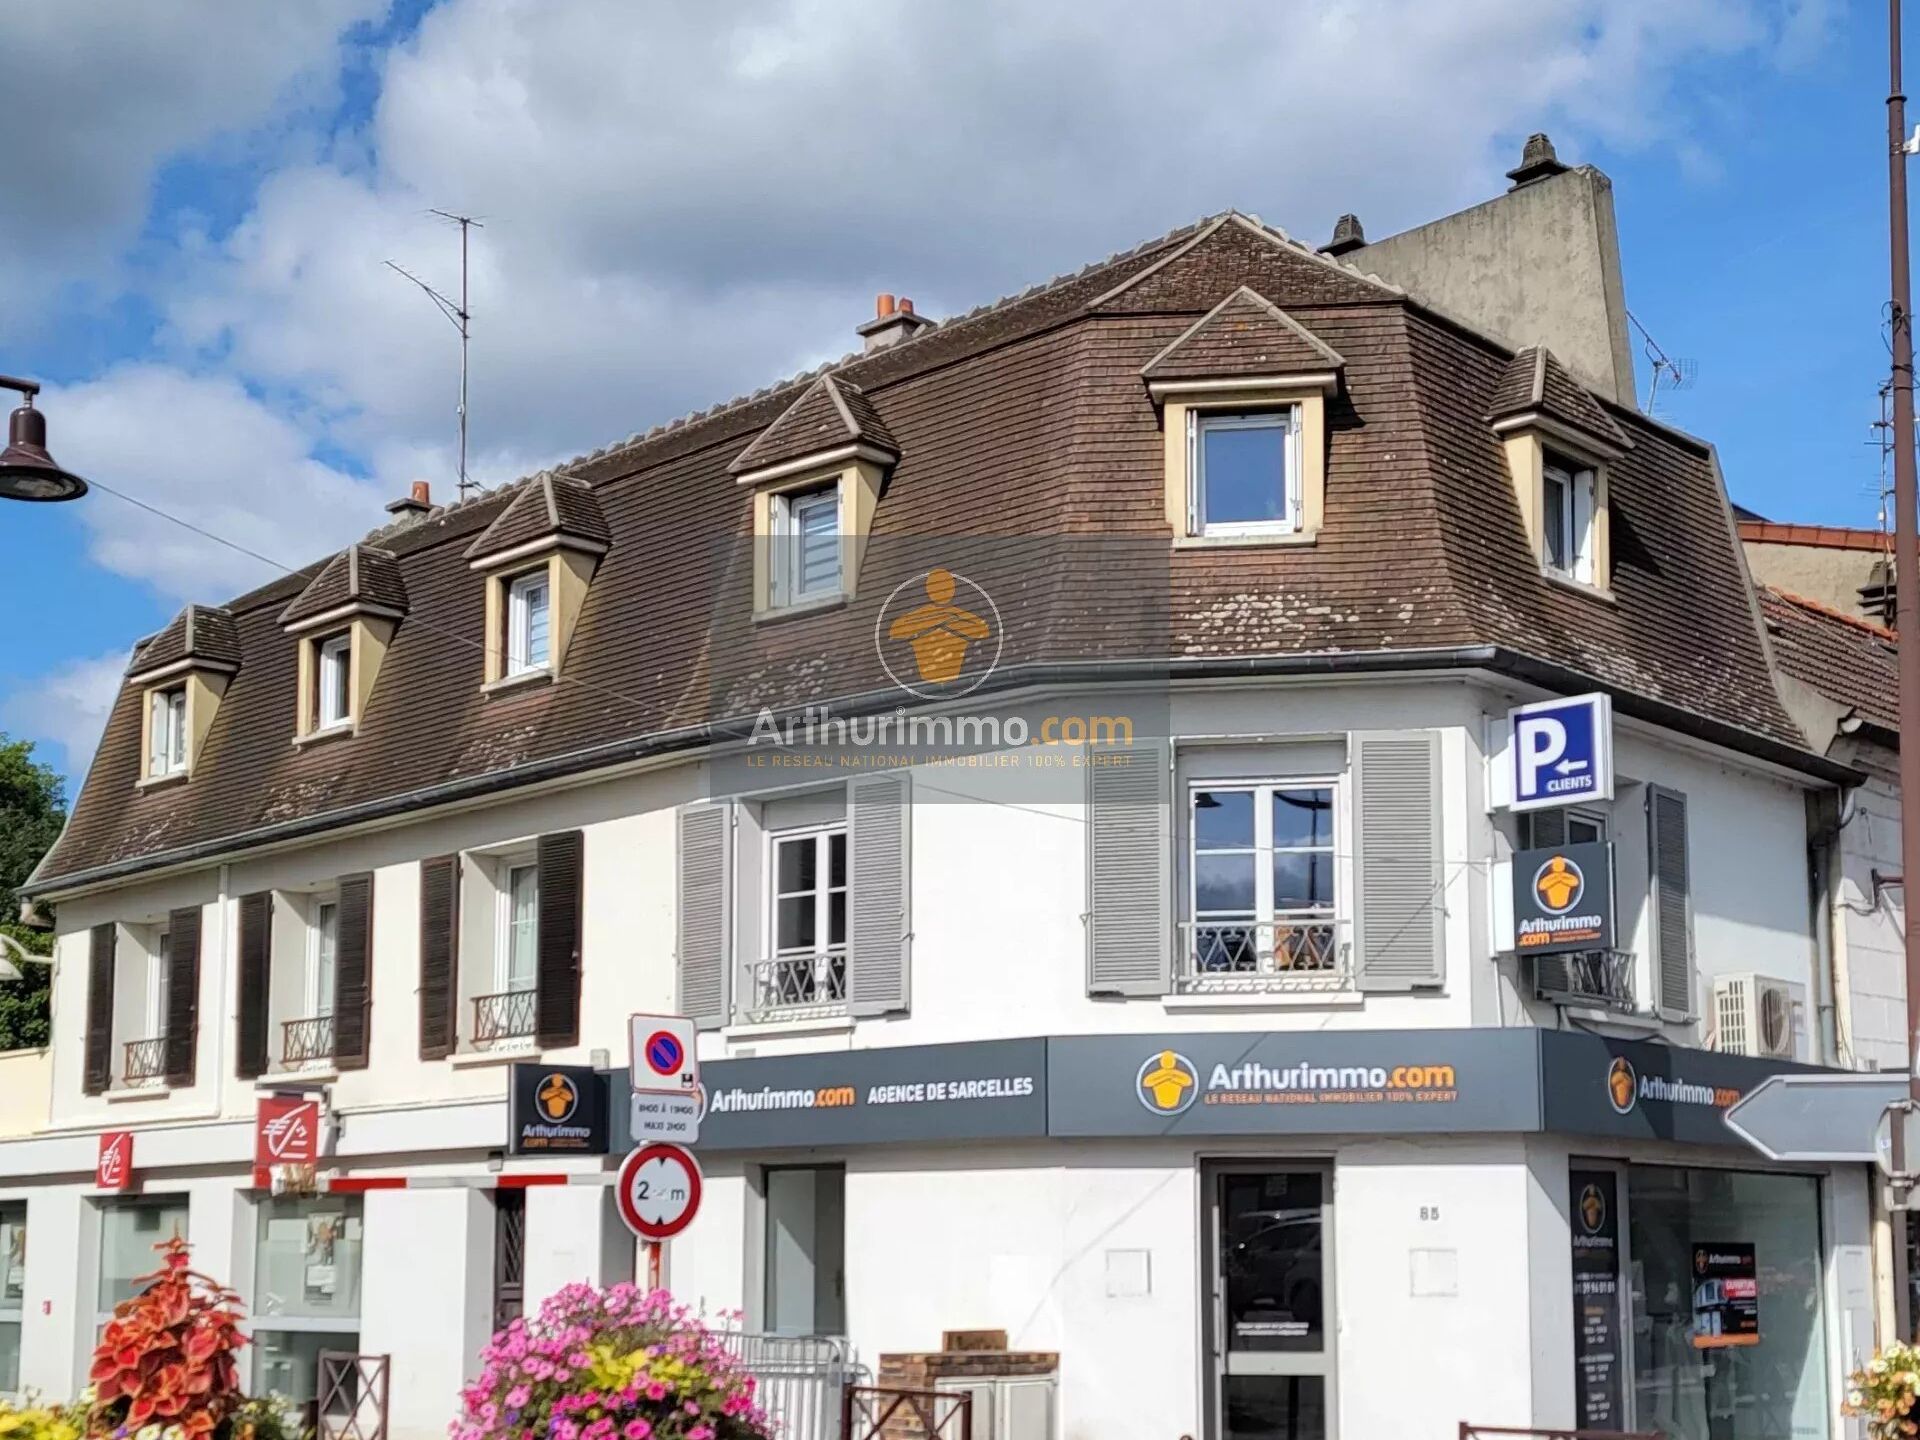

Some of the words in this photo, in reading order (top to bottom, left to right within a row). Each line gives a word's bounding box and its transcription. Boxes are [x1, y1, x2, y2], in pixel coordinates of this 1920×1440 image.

[1519, 717, 1567, 796] P
[1547, 774, 1593, 793] CLIENTS
[1519, 915, 1602, 934] Arthurimmo
[1207, 1061, 1454, 1090] Arthurimmo.com
[710, 1085, 856, 1113] Arthurimmo.com
[867, 1082, 924, 1105] AGENCE
[927, 1081, 947, 1101] DE
[948, 1076, 1034, 1099] SARCELLES
[638, 1181, 649, 1200] 2
[671, 1188, 685, 1200] m
